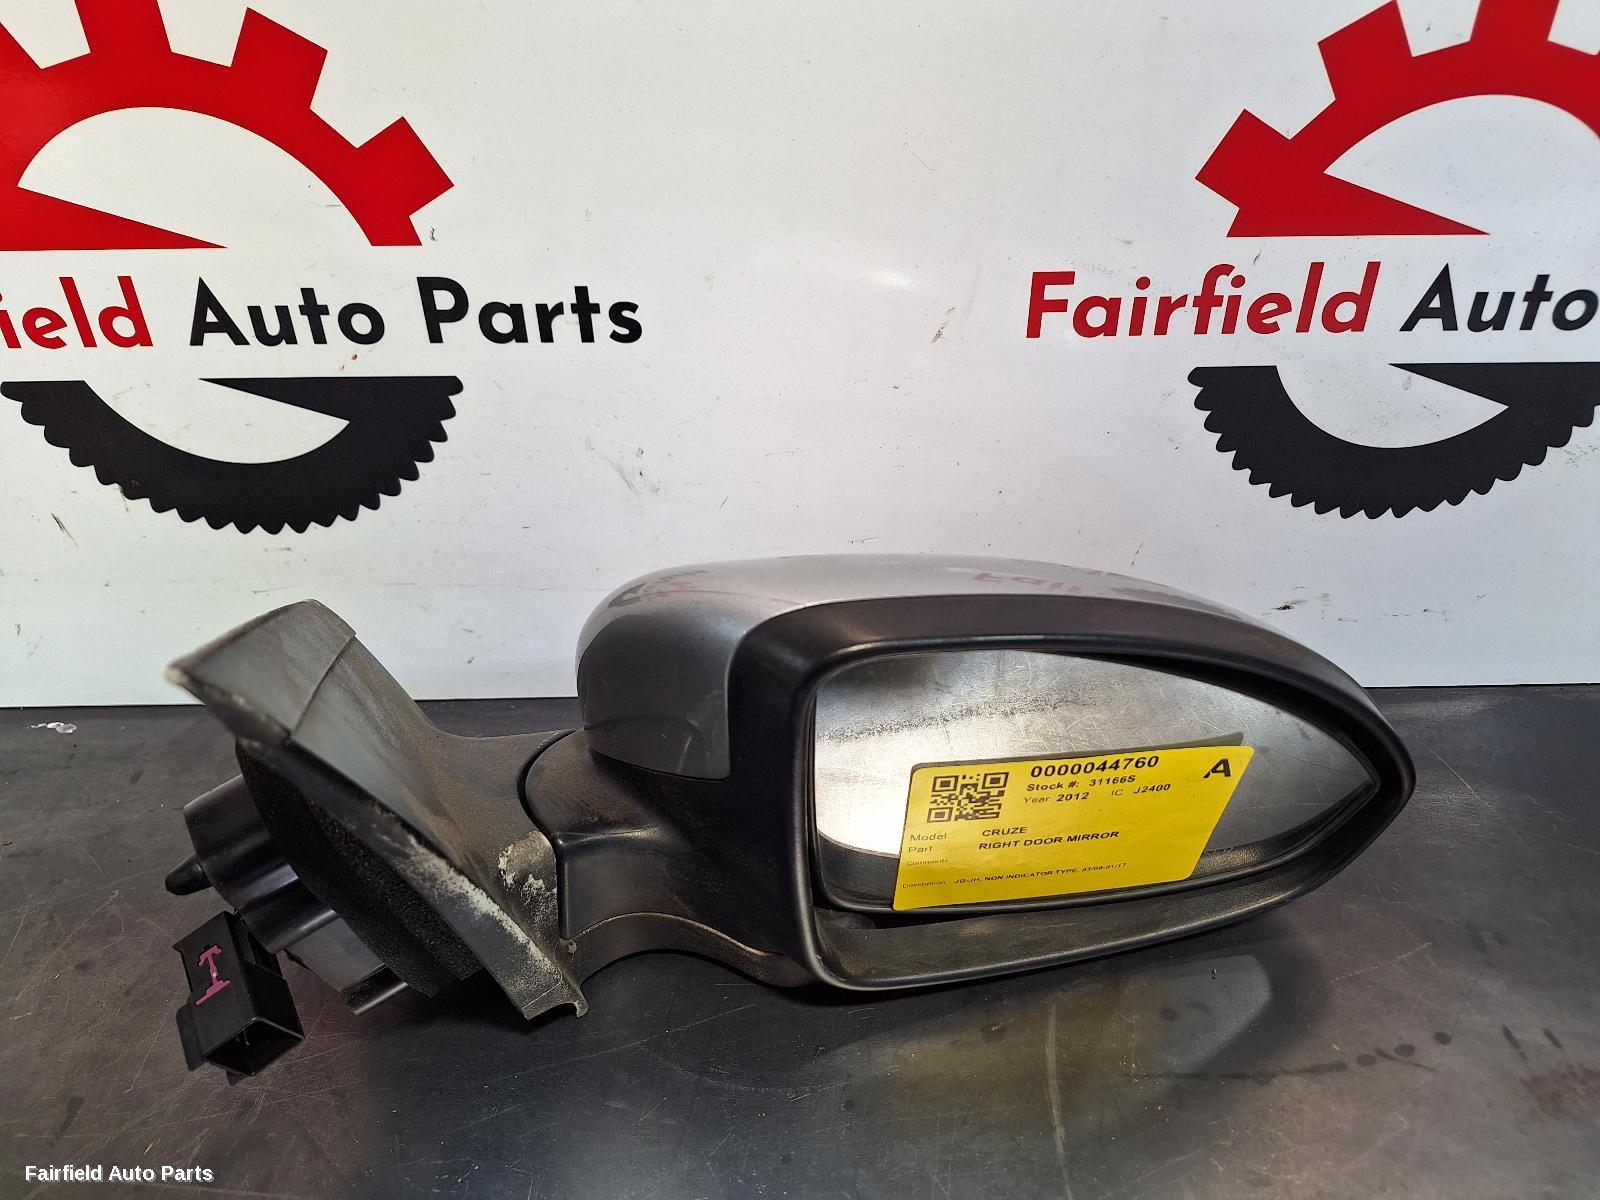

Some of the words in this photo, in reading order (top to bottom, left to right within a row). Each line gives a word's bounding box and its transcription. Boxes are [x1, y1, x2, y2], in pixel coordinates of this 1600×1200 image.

[1026, 261, 1382, 339] Fairfield
[1399, 262, 1600, 333] Auto
[189, 276, 386, 347] Auto
[416, 275, 644, 345] Parts
[1030, 755, 1160, 778] 0000044760
[1203, 758, 1231, 779] A
[1023, 795, 1051, 804] Year
[1056, 791, 1090, 802] 2012
[1111, 788, 1124, 797] IC
[1132, 783, 1172, 795] J2400
[1026, 781, 1064, 792] Stock
[1088, 774, 1137, 787] 31166S
[908, 845, 933, 854] Part
[978, 840, 1021, 850] RIGHT
[1023, 836, 1063, 847] DOOR
[1066, 831, 1121, 843] MIRROR
[909, 832, 947, 842] Model
[981, 826, 1029, 837] CRUZE
[984, 874, 1004, 882] NON
[1005, 870, 1053, 880] INDICATOR
